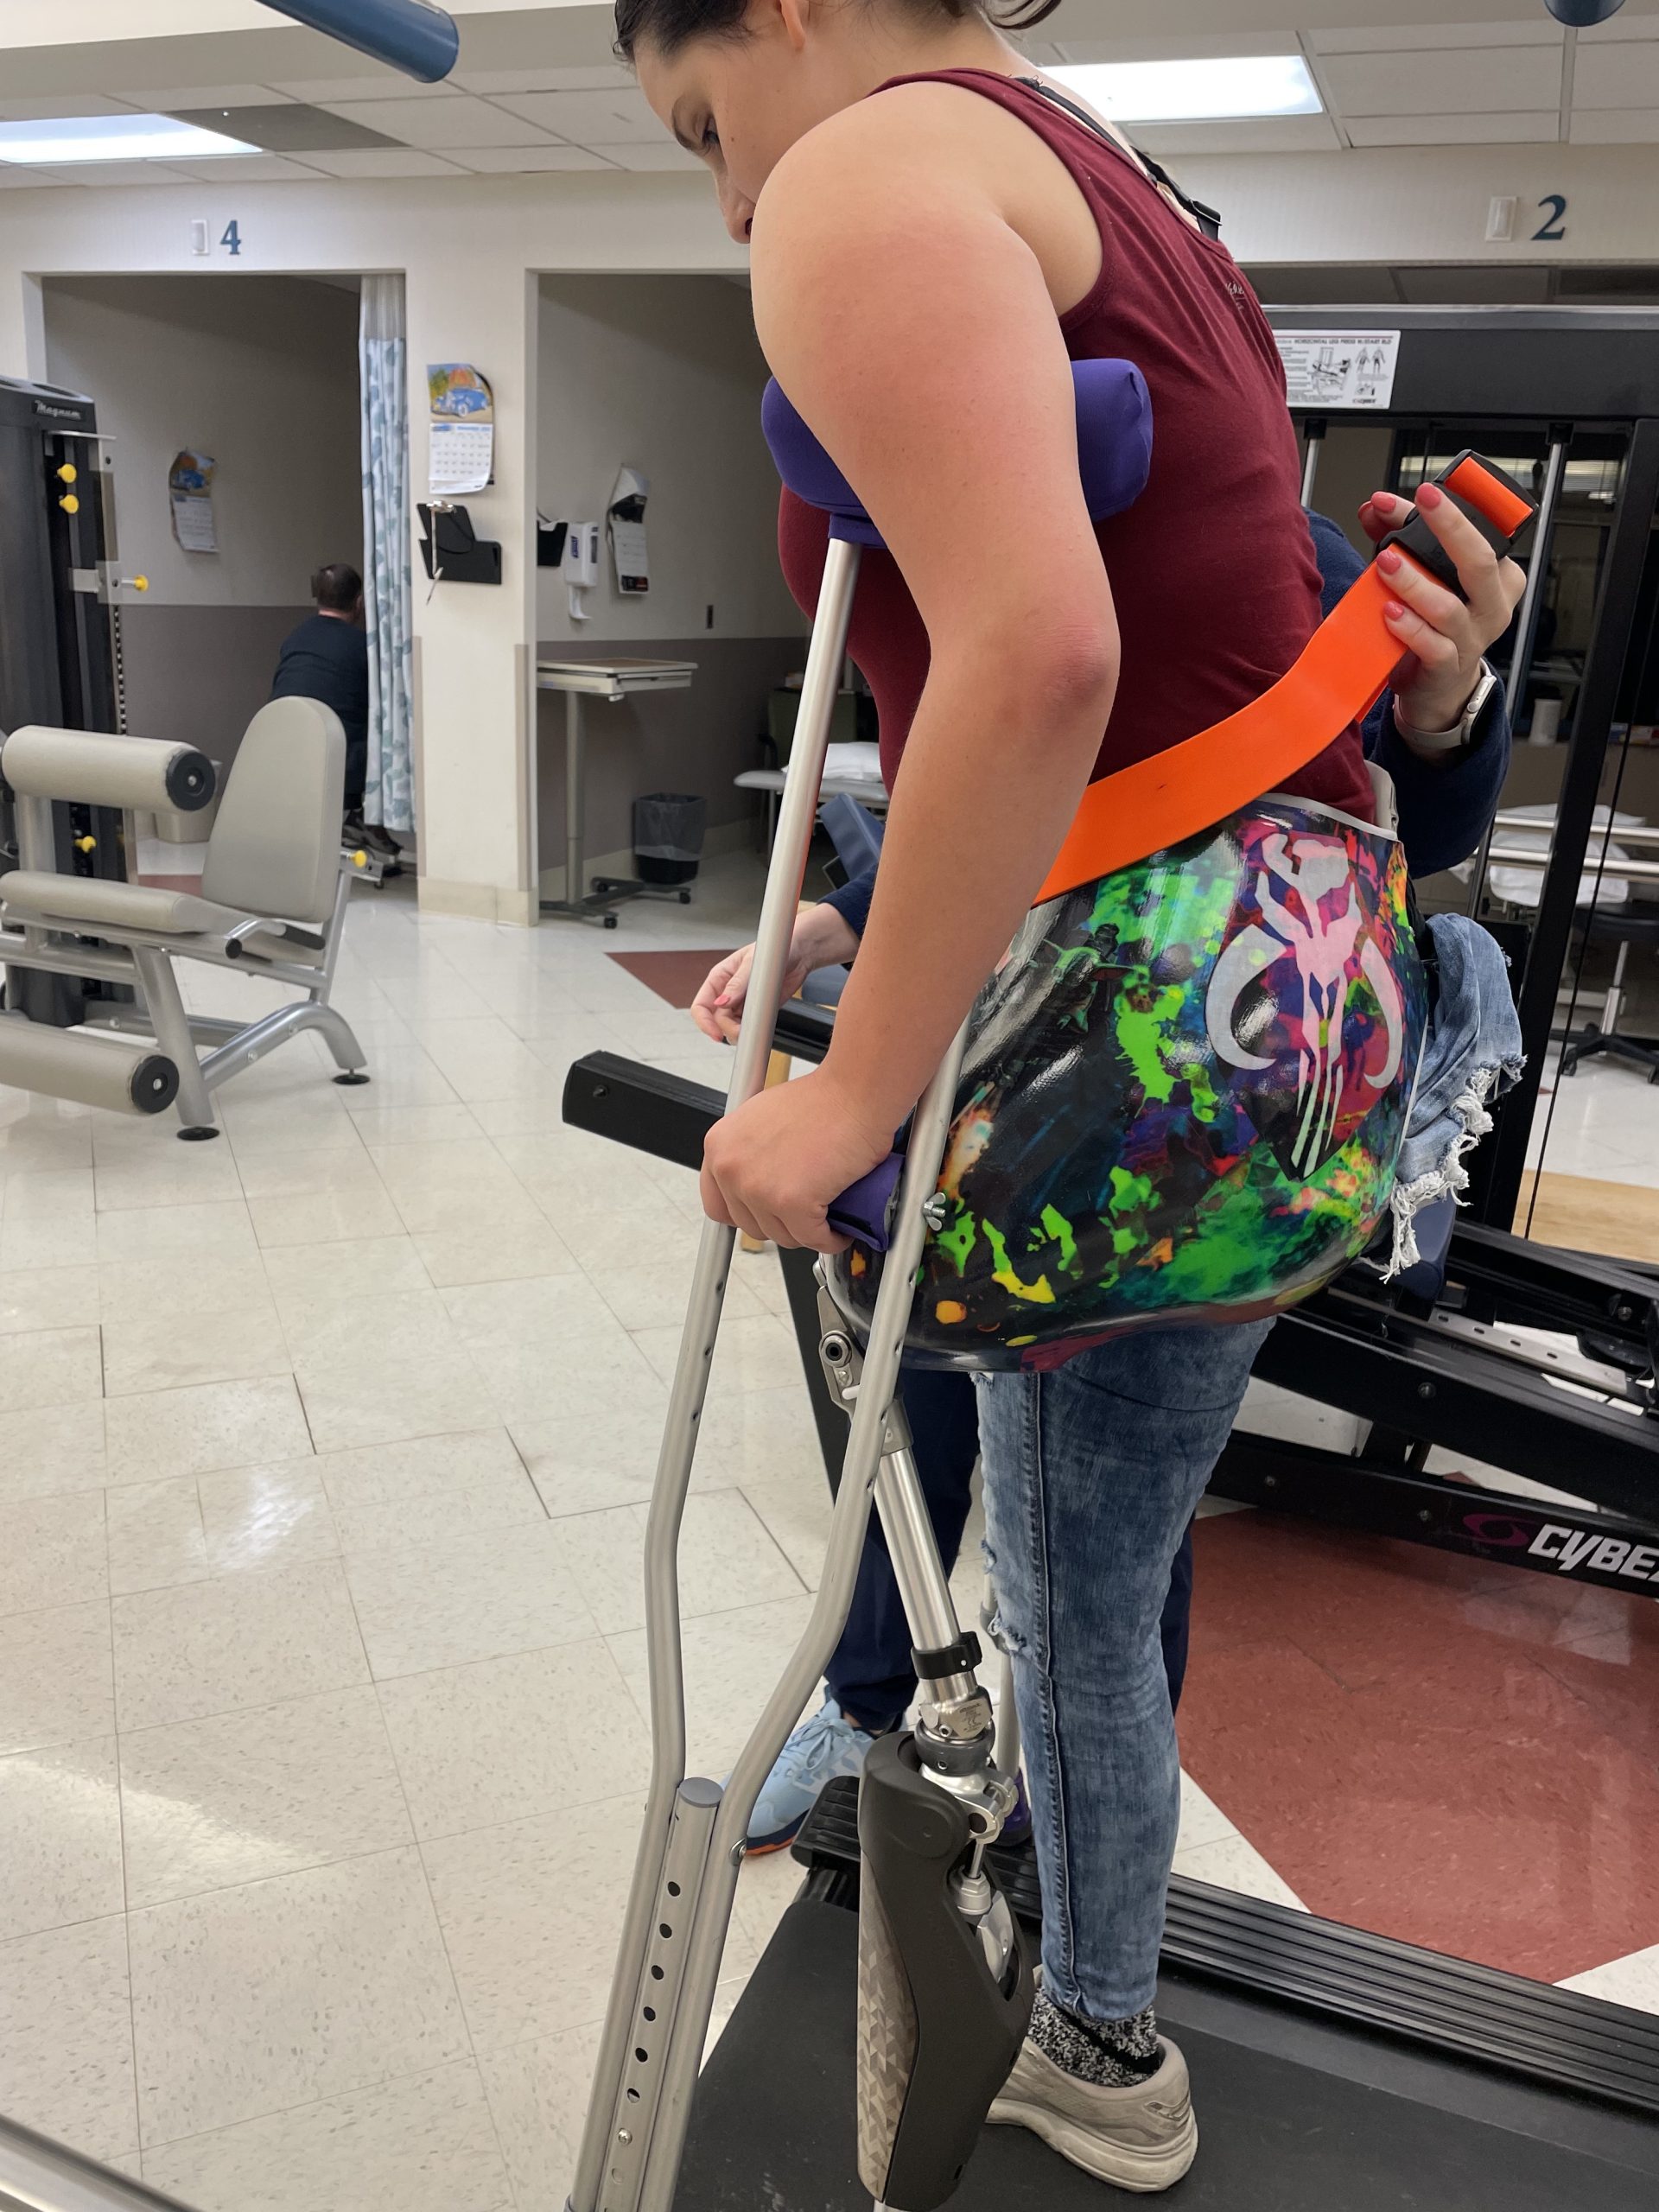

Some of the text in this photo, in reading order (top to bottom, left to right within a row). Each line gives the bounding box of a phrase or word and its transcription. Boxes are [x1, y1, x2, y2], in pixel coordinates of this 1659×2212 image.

[219, 219, 241, 255] 4
[1530, 194, 1566, 240] 2
[35, 399, 81, 420] Magnum
[1528, 1523, 1659, 1583] CYBE
